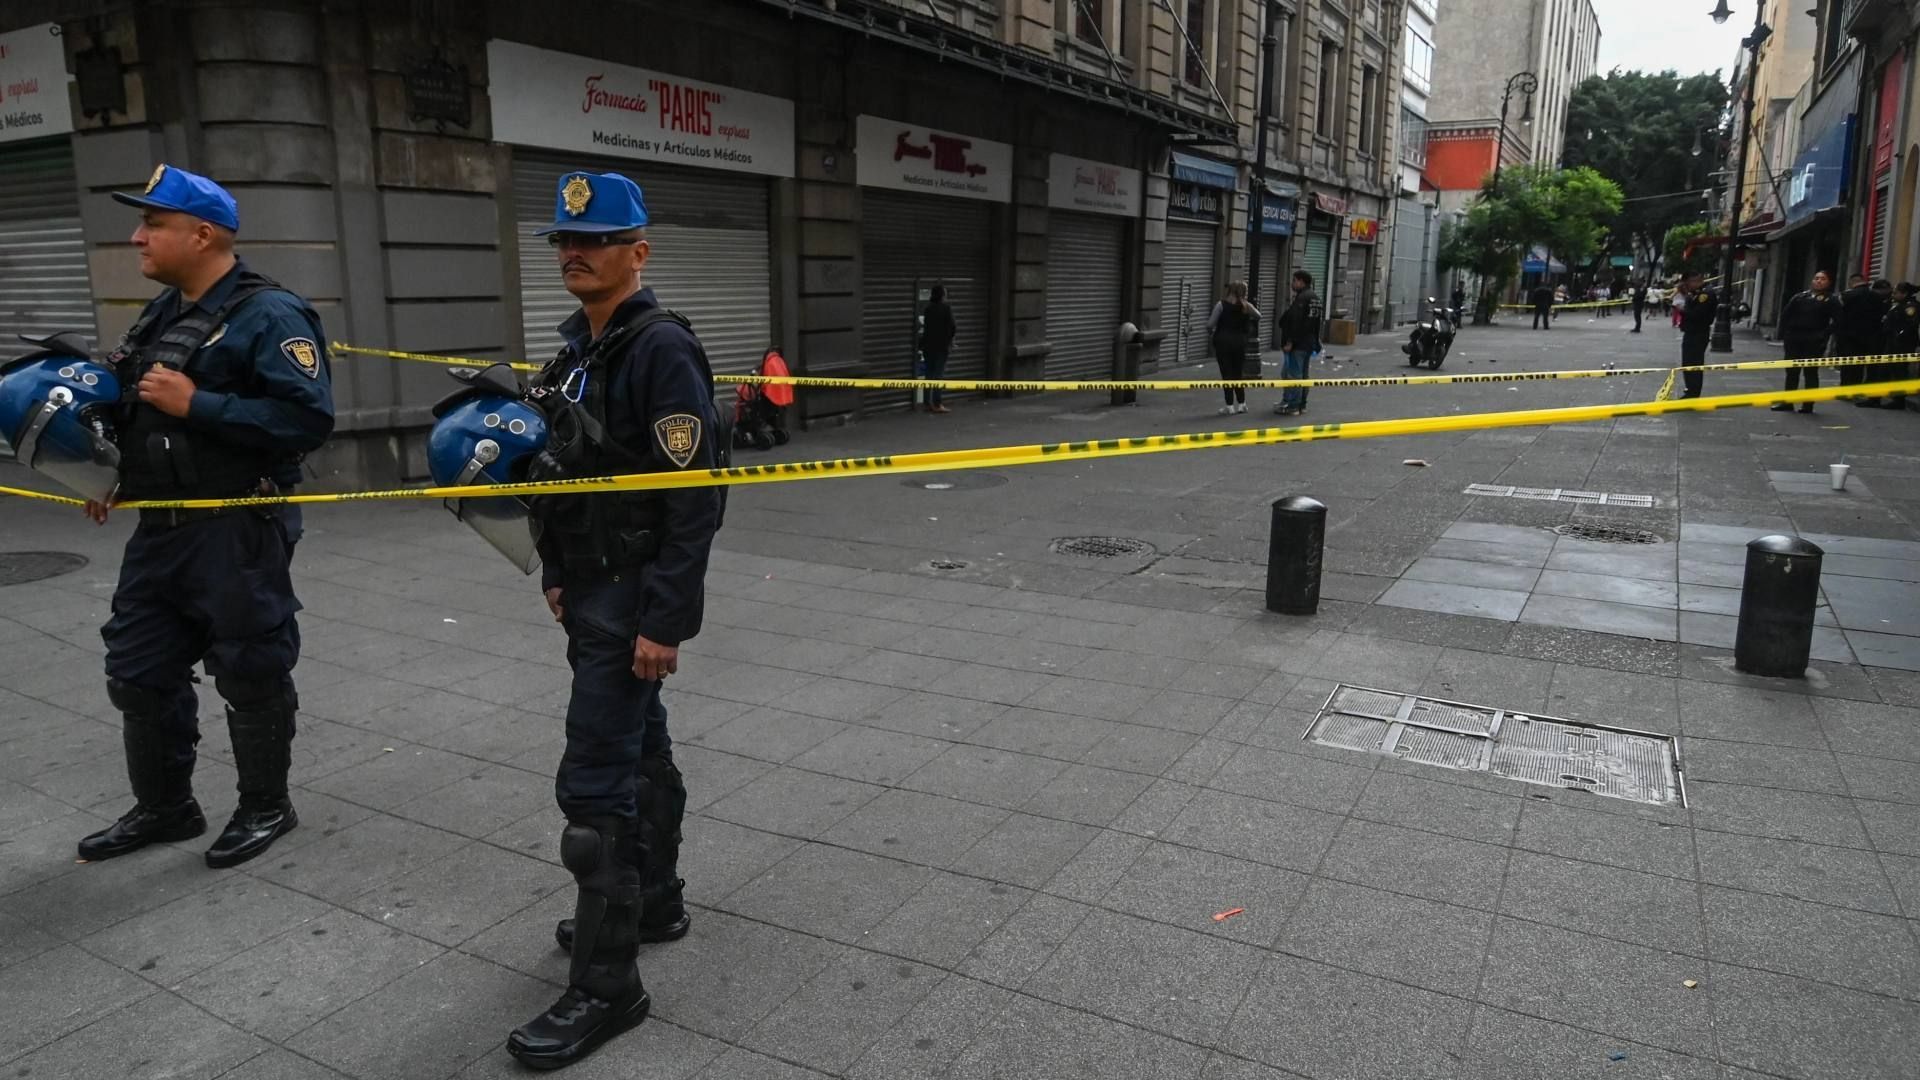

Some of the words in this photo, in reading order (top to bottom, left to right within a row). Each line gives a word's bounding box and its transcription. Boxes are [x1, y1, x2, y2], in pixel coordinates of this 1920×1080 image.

[582, 74, 648, 114] Farmacia
[718, 125, 751, 143] express
[592, 130, 651, 152] Medicinas
[653, 142, 660, 154] y
[663, 142, 711, 160] Artículos
[713, 148, 752, 163] Médicos
[660, 418, 695, 431] POLICIA
